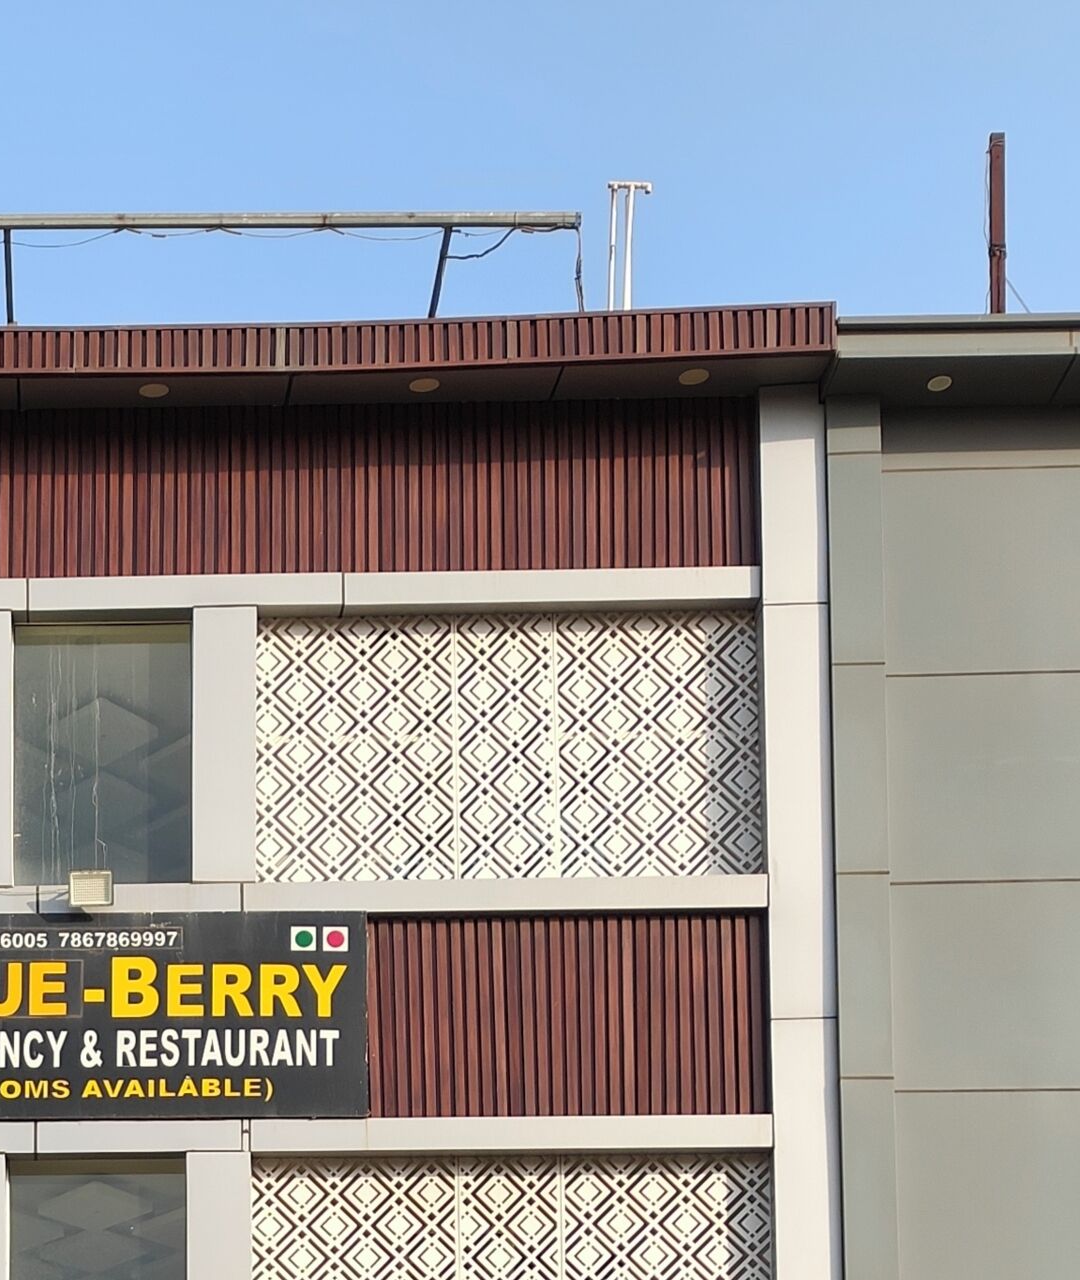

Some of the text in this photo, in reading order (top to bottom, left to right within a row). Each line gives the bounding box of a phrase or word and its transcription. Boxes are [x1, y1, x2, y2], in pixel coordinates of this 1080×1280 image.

[58, 930, 178, 949] 7867869997
[80, 1033, 103, 1068] &
[116, 1029, 340, 1068] RESTAURANT
[81, 1076, 274, 1101] AVAILABLE)
